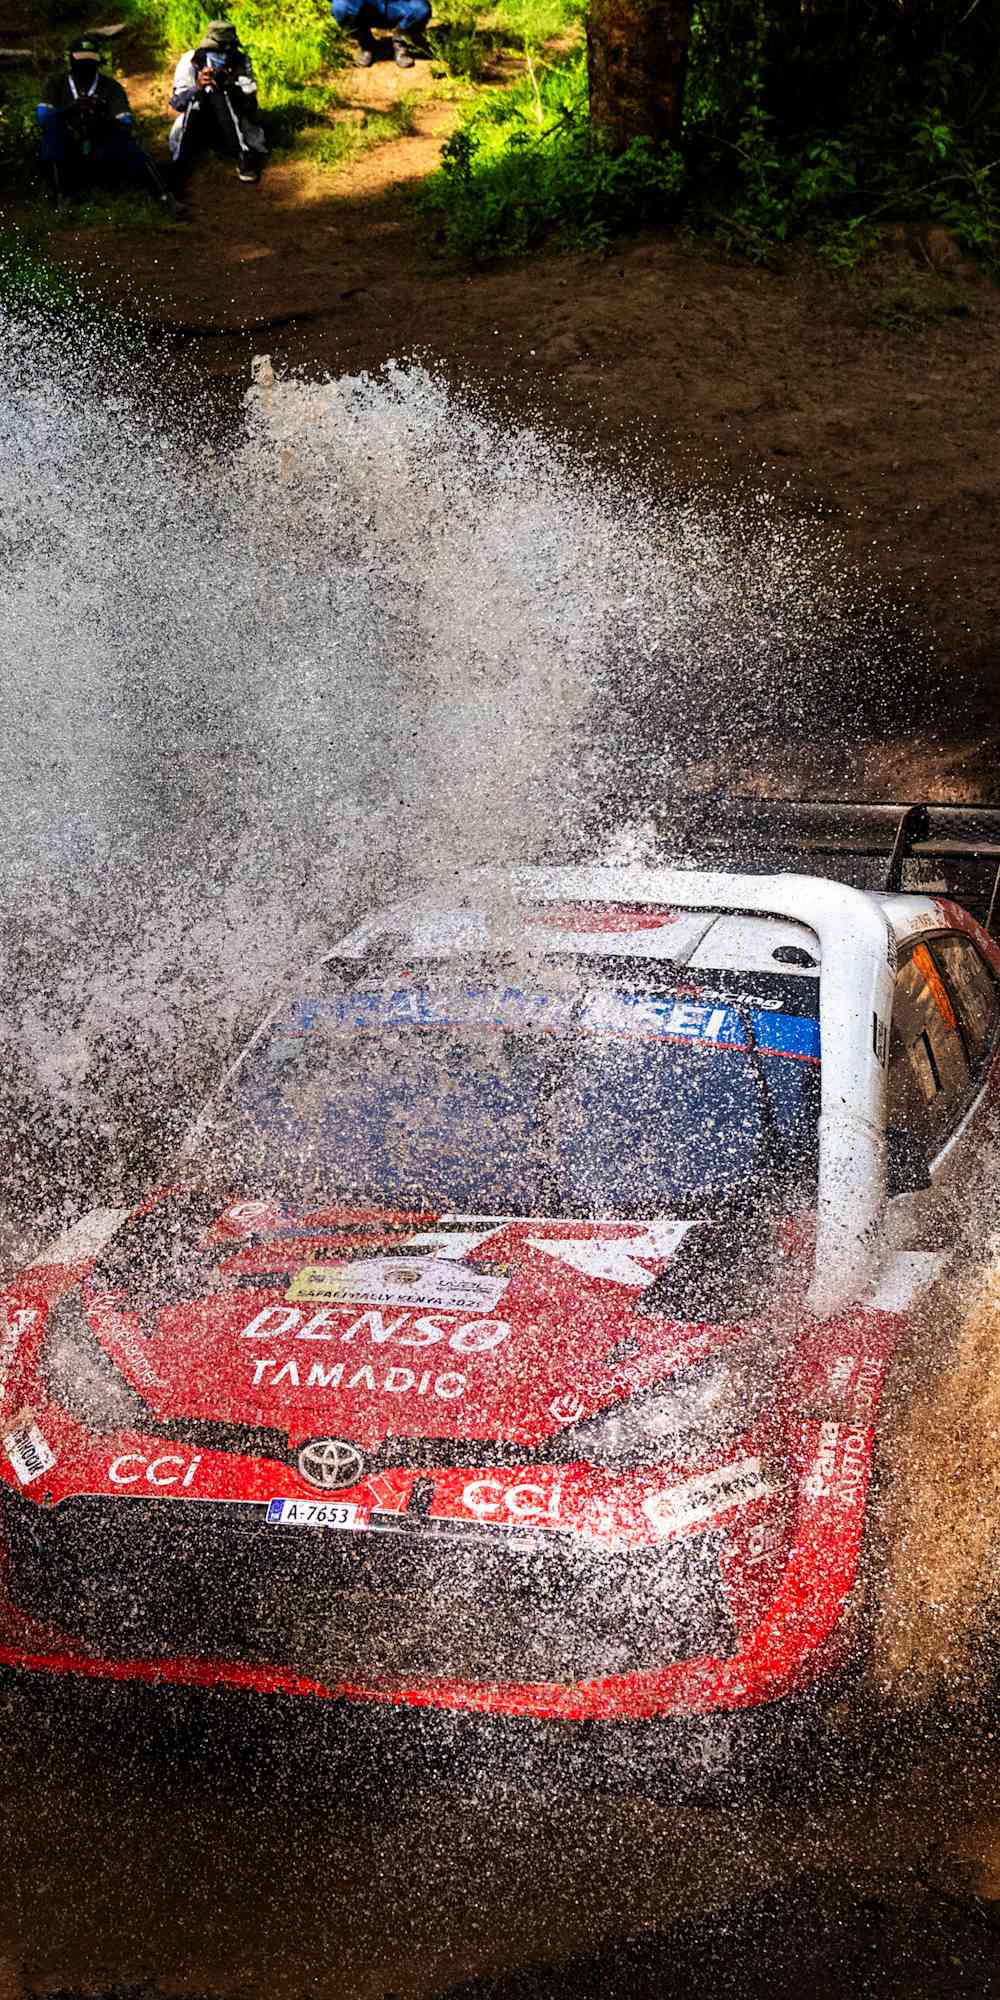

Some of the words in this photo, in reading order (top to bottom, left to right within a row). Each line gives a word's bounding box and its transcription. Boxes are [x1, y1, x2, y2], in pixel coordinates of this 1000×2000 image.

[397, 1294, 443, 1306] KENYA
[239, 1306, 512, 1353] DENSO
[252, 1359, 467, 1398] TAMADIC
[287, 1504, 350, 1523] A-7653
